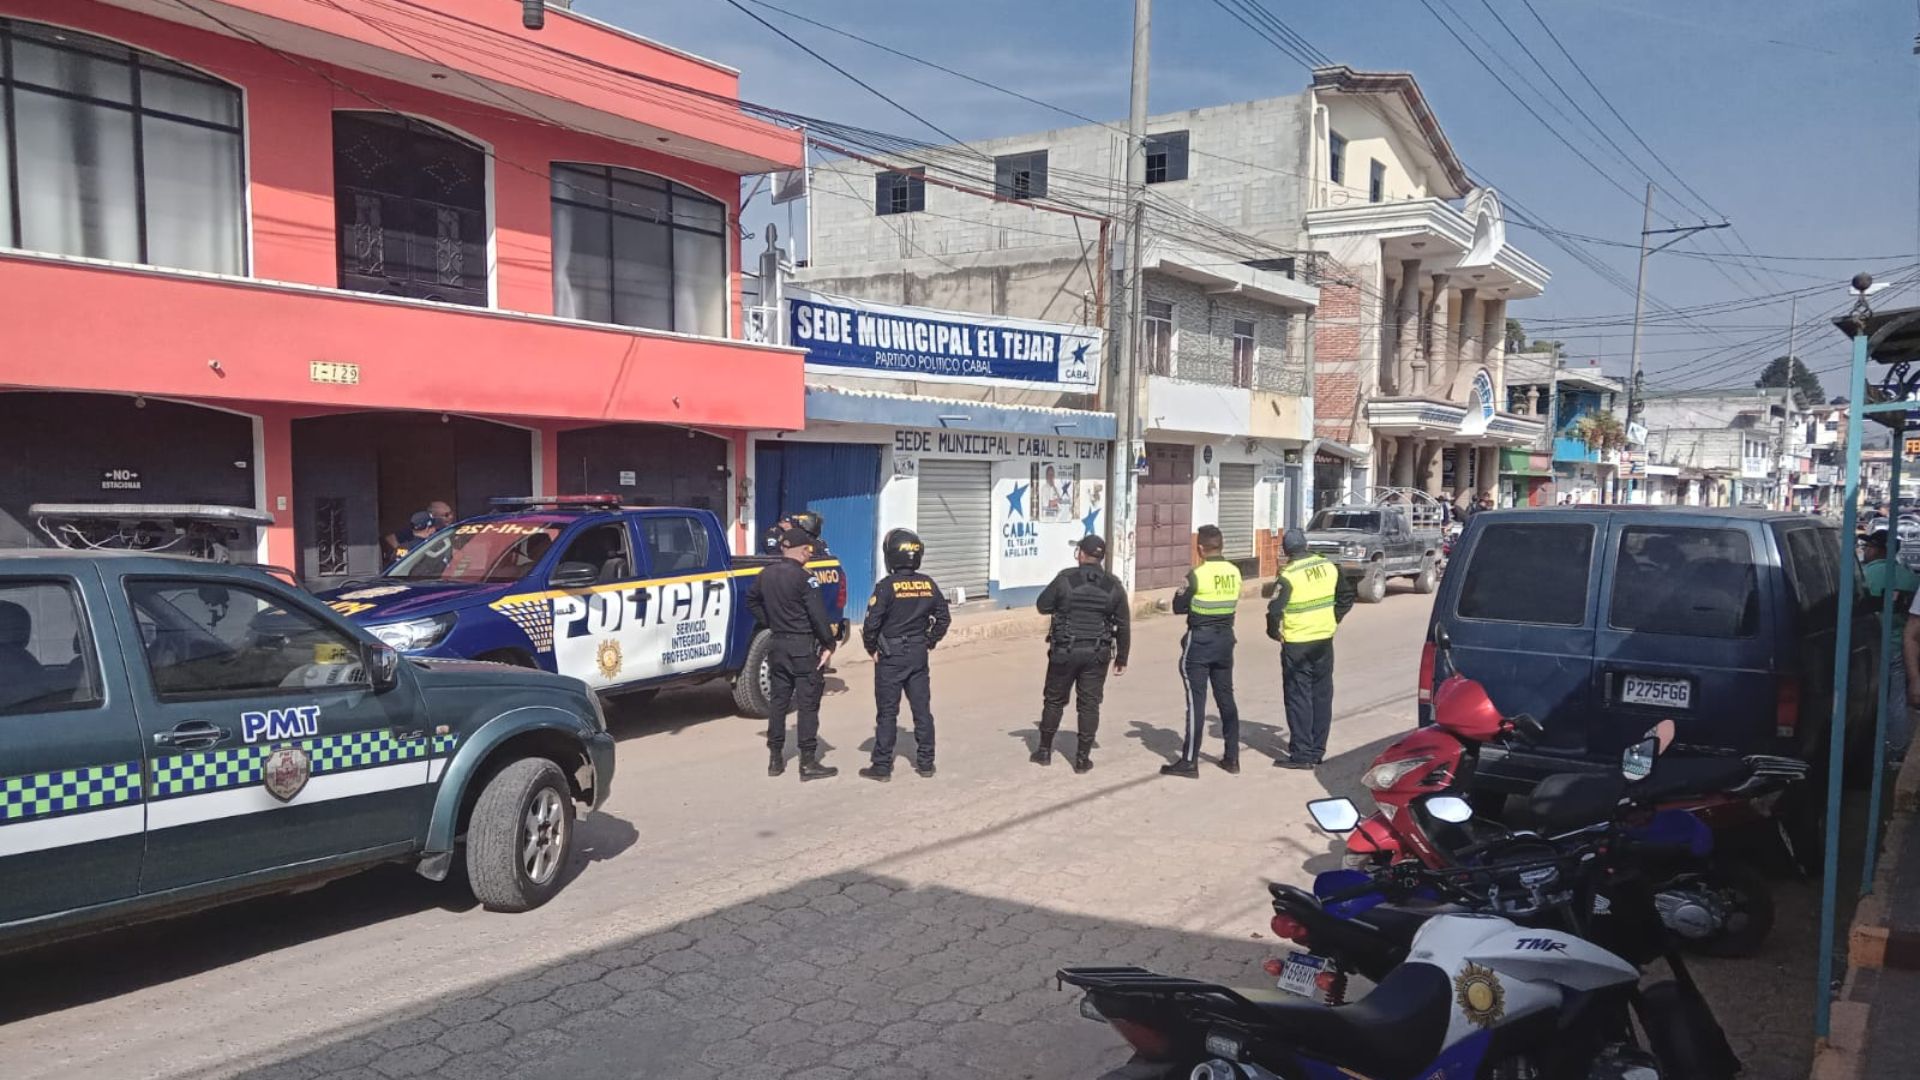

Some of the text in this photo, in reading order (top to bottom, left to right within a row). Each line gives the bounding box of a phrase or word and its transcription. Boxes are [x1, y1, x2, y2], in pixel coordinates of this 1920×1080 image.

[798, 305, 1055, 363] SEDE MUNICIPAL EL TEJAR
[875, 351, 993, 374] PARTIDO POLITICO CABAL
[1065, 369, 1090, 380] CABAL
[895, 430, 1105, 460] SEDE MUNICIPAL CABAL EL TEJAR
[112, 469, 131, 481] NO
[1002, 521, 1039, 538] CABAL
[1213, 574, 1236, 590] PMT
[1304, 565, 1328, 582] PMT
[893, 580, 932, 592] POLICIA
[552, 579, 727, 638] POLICIA
[676, 620, 707, 635] SERVICIO
[671, 632, 710, 649] INTEGRIDAD
[662, 643, 722, 665] PROFESIONALISMO
[1626, 680, 1688, 701] P275FGG
[241, 705, 321, 743] PMT
[1514, 938, 1571, 957] TMR
